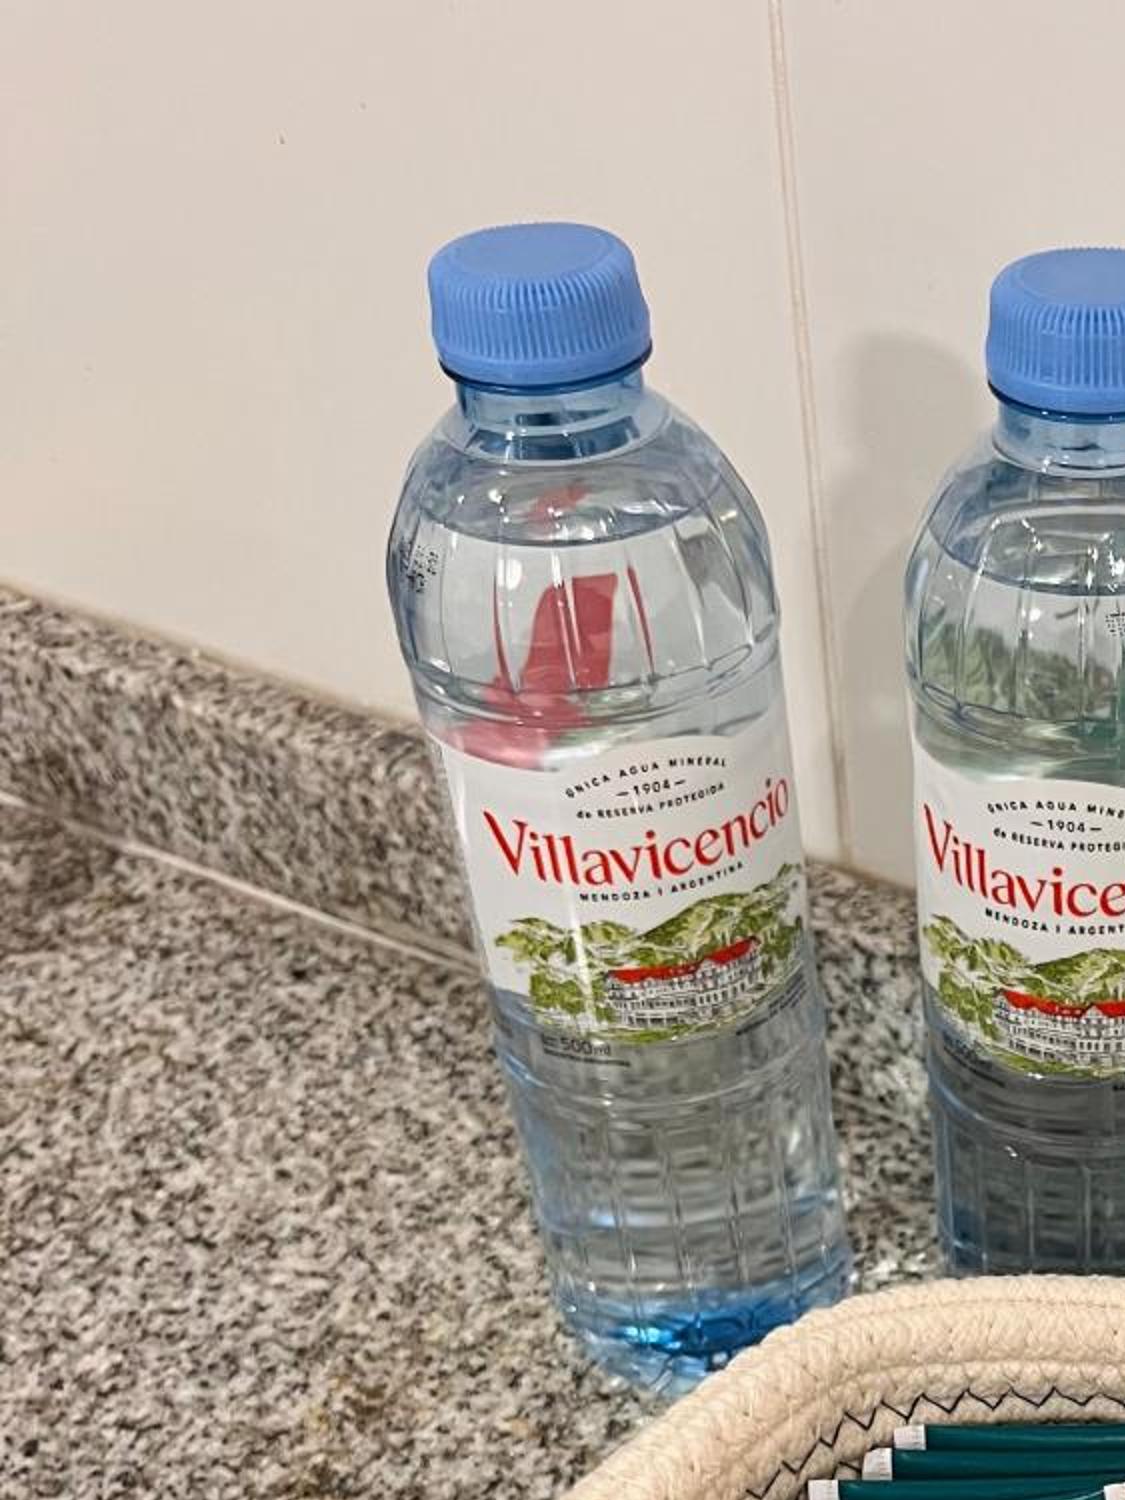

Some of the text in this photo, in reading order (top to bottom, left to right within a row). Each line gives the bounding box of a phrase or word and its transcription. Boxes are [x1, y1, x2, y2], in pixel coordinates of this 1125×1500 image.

[619, 762, 659, 777] AGUA
[669, 757, 727, 768] MINERAL
[633, 779, 671, 797] 1904
[576, 782, 725, 819] de RESERVA PROTEGIDA
[1036, 801, 1077, 811] AGUA
[483, 778, 789, 886] Villavicencio
[1048, 820, 1086, 833] 1904
[994, 827, 1006, 839] de
[1011, 832, 1065, 850] RESERVA
[579, 890, 651, 901] MENDOZA
[671, 861, 743, 894] ARGENTINA
[985, 908, 1049, 932] MENDOZA
